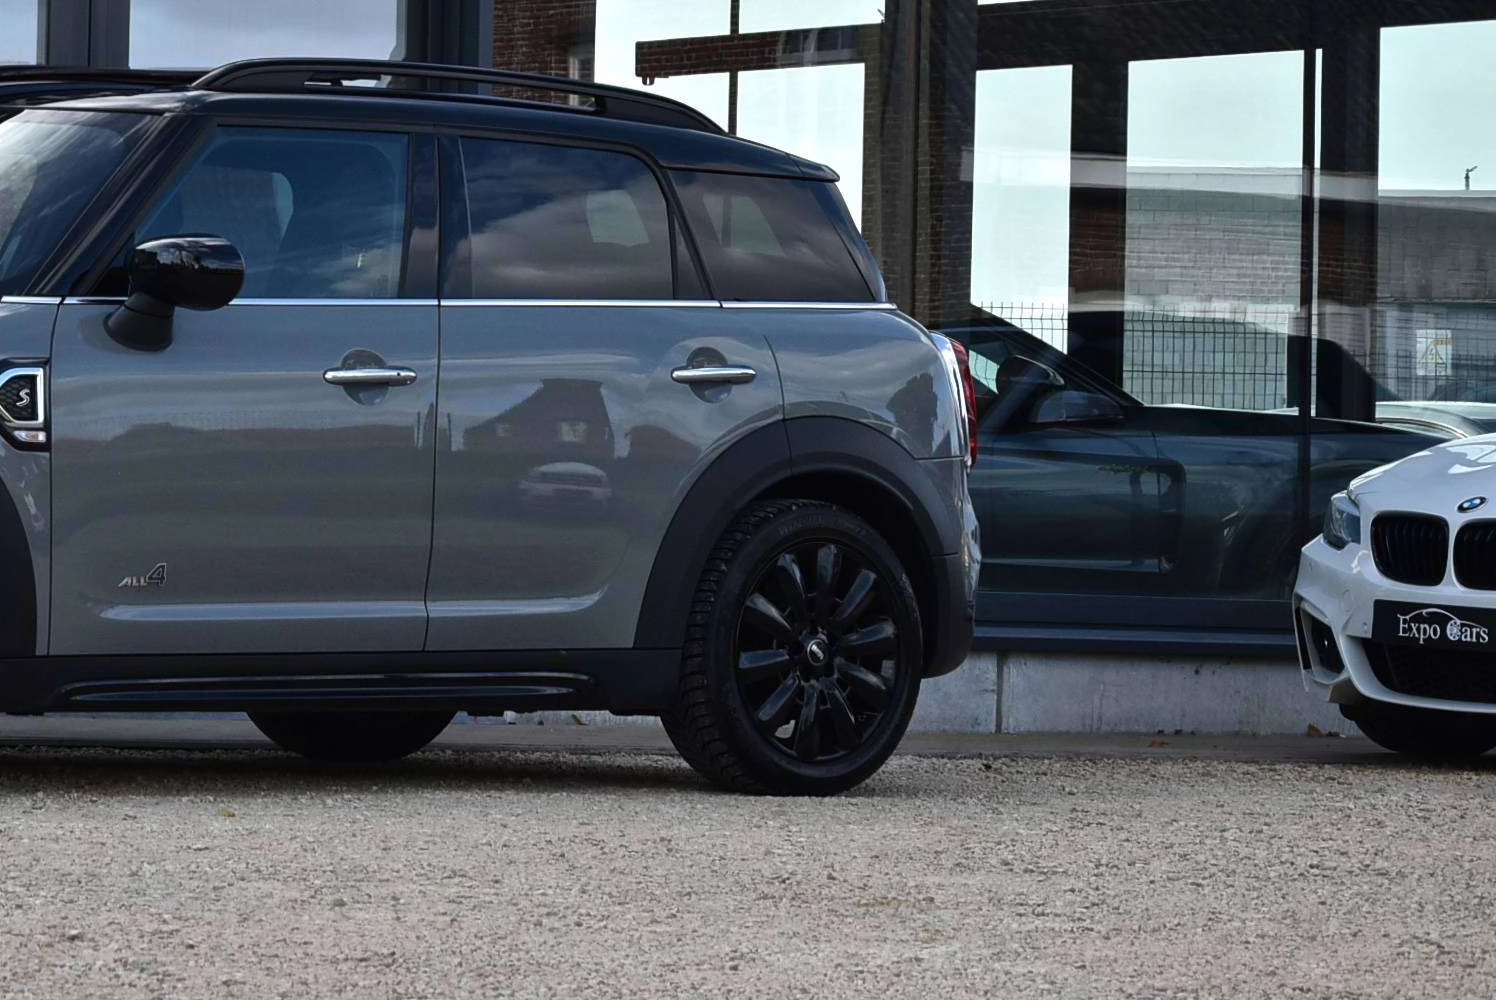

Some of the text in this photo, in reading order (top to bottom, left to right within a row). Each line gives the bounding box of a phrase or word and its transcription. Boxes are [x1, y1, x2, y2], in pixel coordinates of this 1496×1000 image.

[16, 388, 31, 407] S
[1397, 614, 1489, 644] Expo Cars
